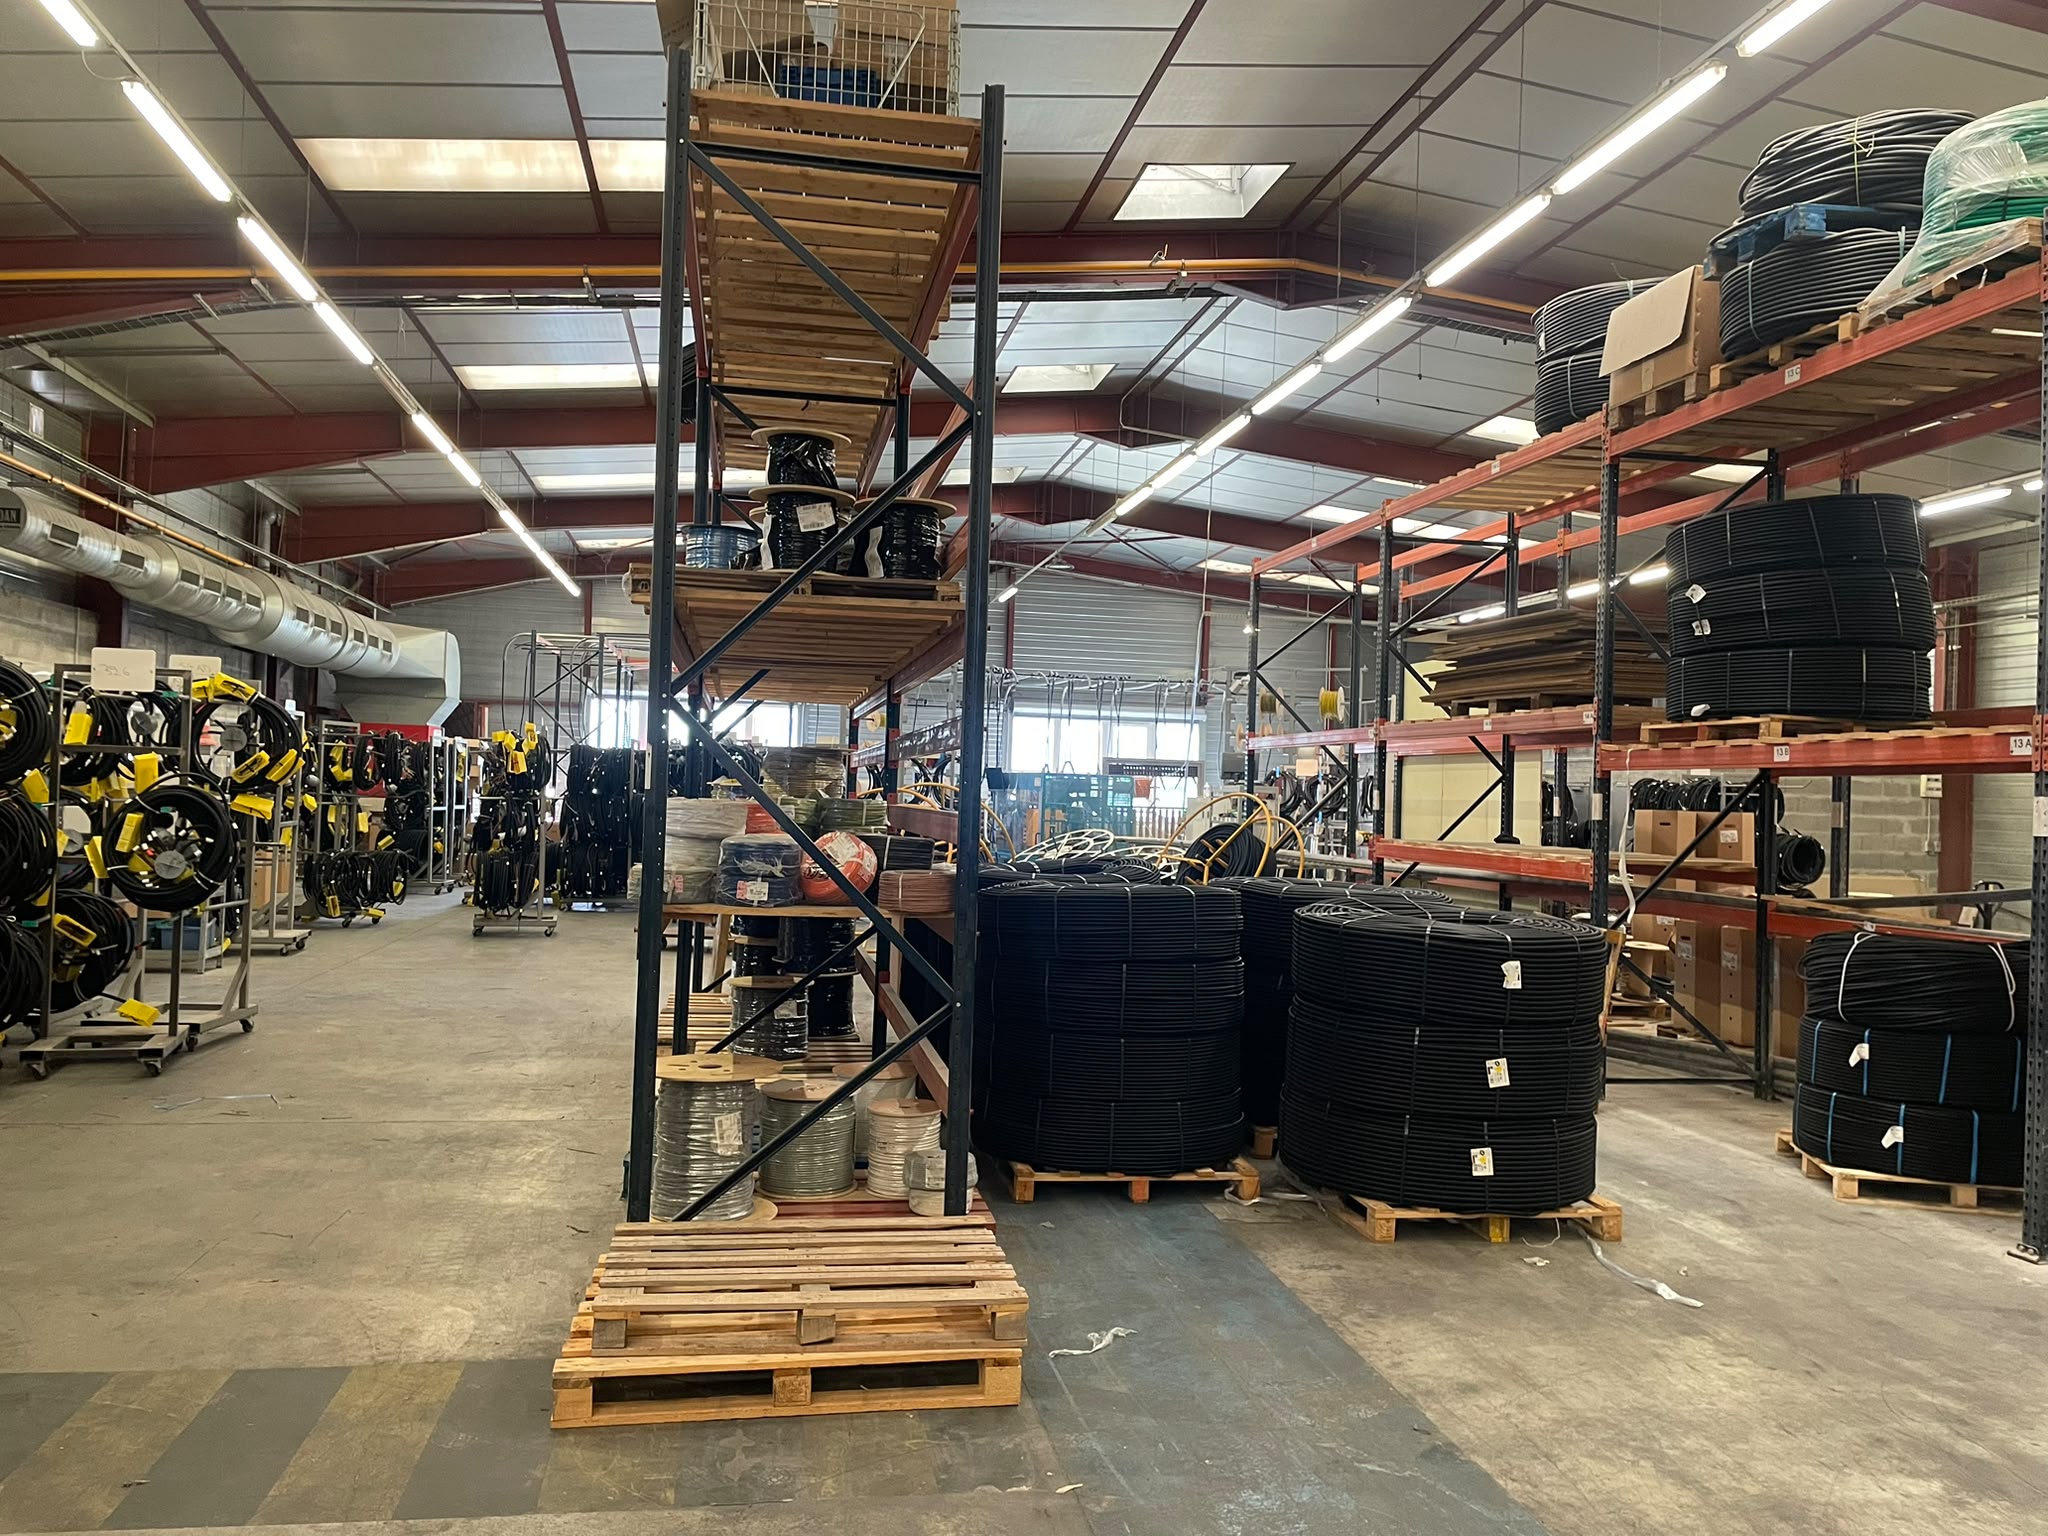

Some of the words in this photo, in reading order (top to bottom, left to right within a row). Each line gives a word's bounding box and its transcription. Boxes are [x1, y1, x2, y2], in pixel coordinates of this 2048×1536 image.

[2013, 738, 2024, 748] 13
[2025, 738, 2032, 748] A
[1776, 747, 1784, 756] 13
